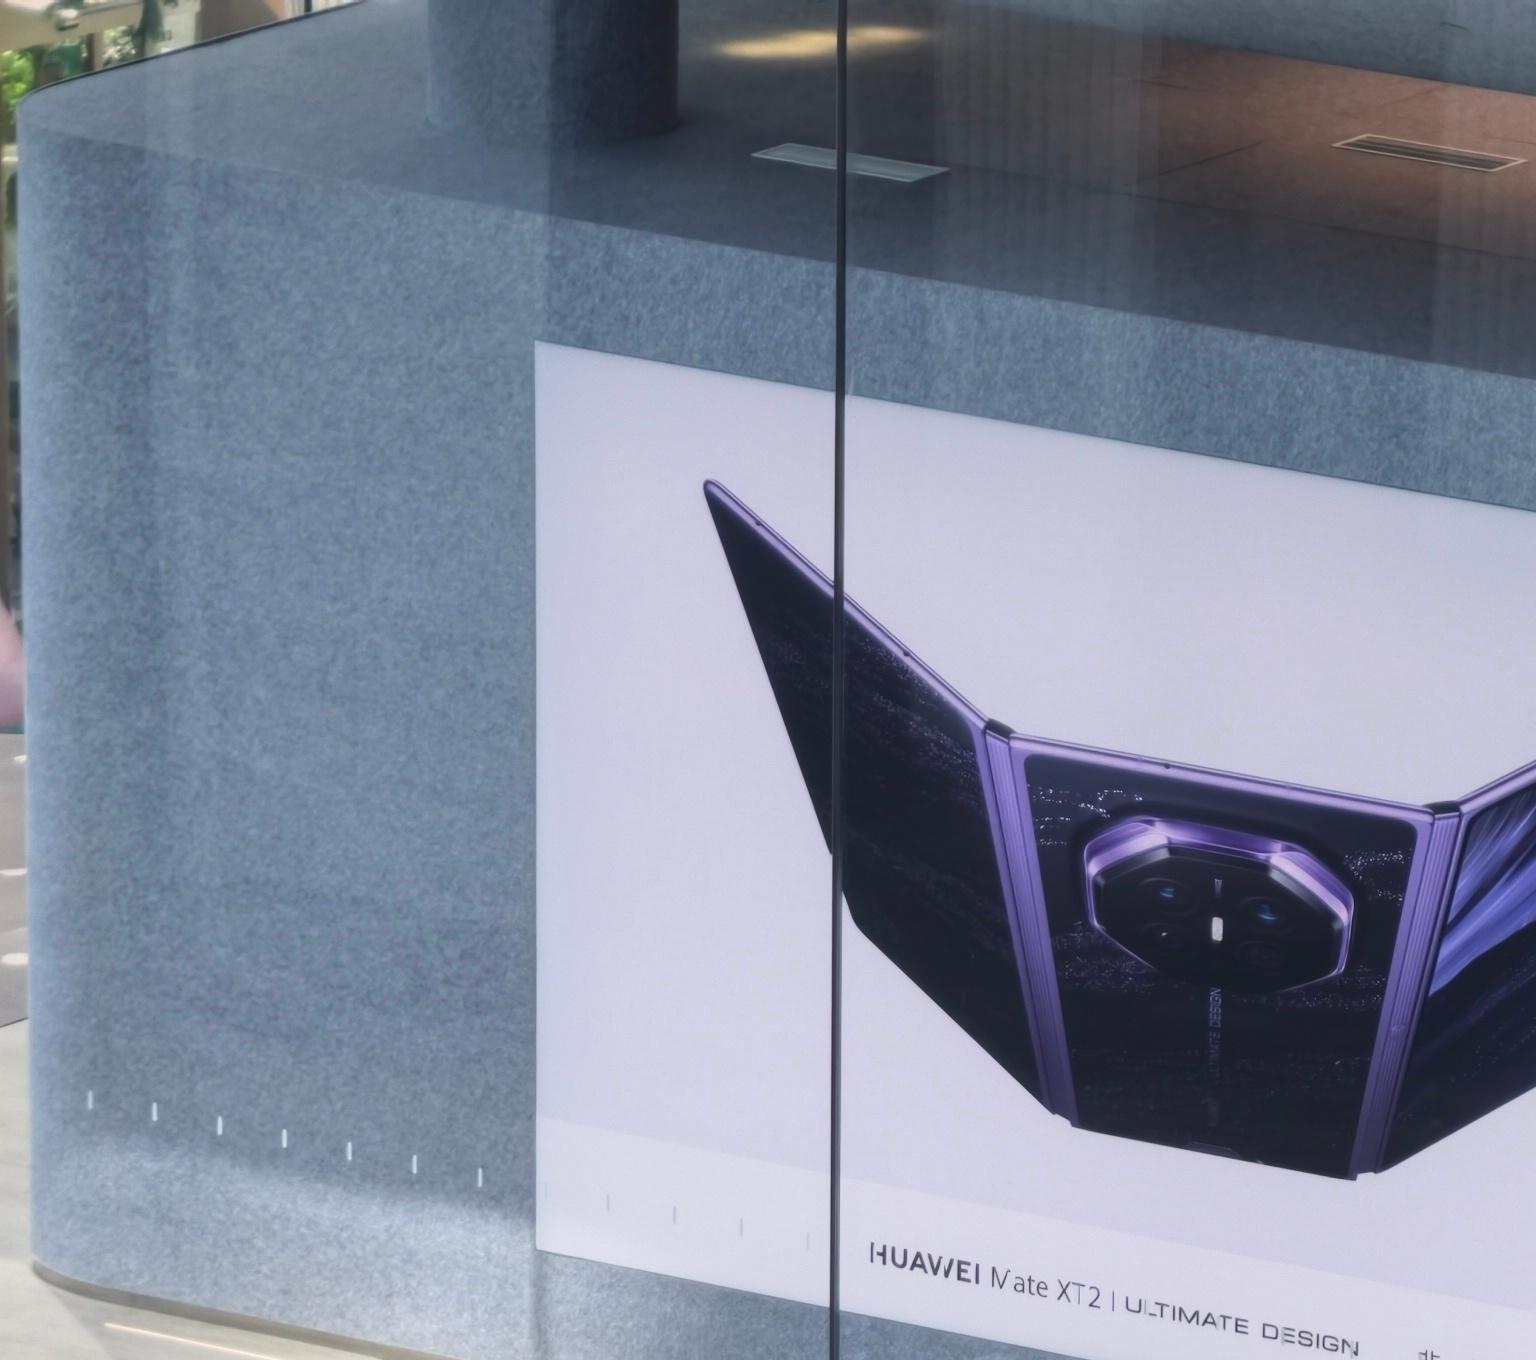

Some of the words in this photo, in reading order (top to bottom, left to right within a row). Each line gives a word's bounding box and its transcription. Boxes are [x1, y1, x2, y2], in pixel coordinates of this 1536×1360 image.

[870, 1241, 980, 1285] HUAWEI
[1056, 1279, 1101, 1309] XT2
[1125, 1296, 1249, 1335] ULTIMATE
[1261, 1322, 1359, 1358] DESIGN
